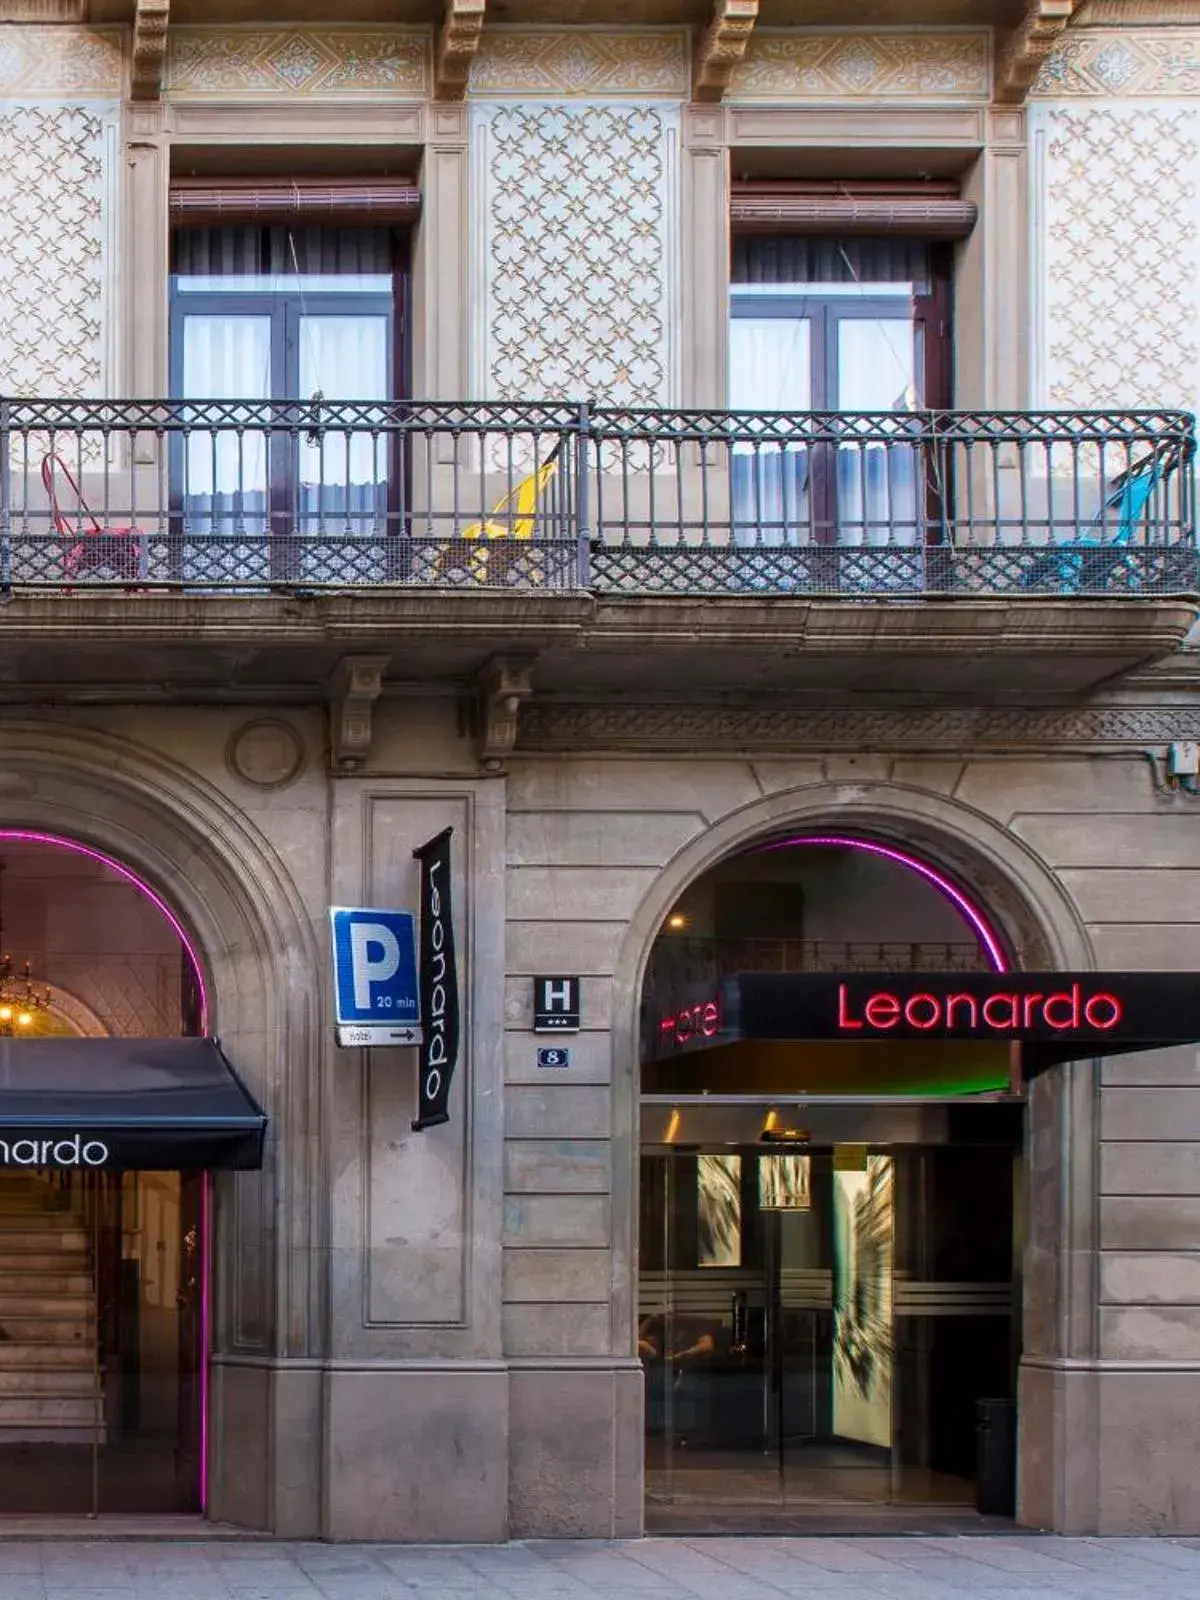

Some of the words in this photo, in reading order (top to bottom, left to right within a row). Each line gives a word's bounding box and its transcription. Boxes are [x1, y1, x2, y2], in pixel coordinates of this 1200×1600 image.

[349, 922, 400, 1009] P
[426, 860, 448, 1100] Leonardo
[376, 995, 392, 1008] 20
[396, 997, 416, 1009] min
[544, 980, 570, 1011] H
[837, 982, 1123, 1030] Leonardo
[546, 1050, 559, 1064] 8
